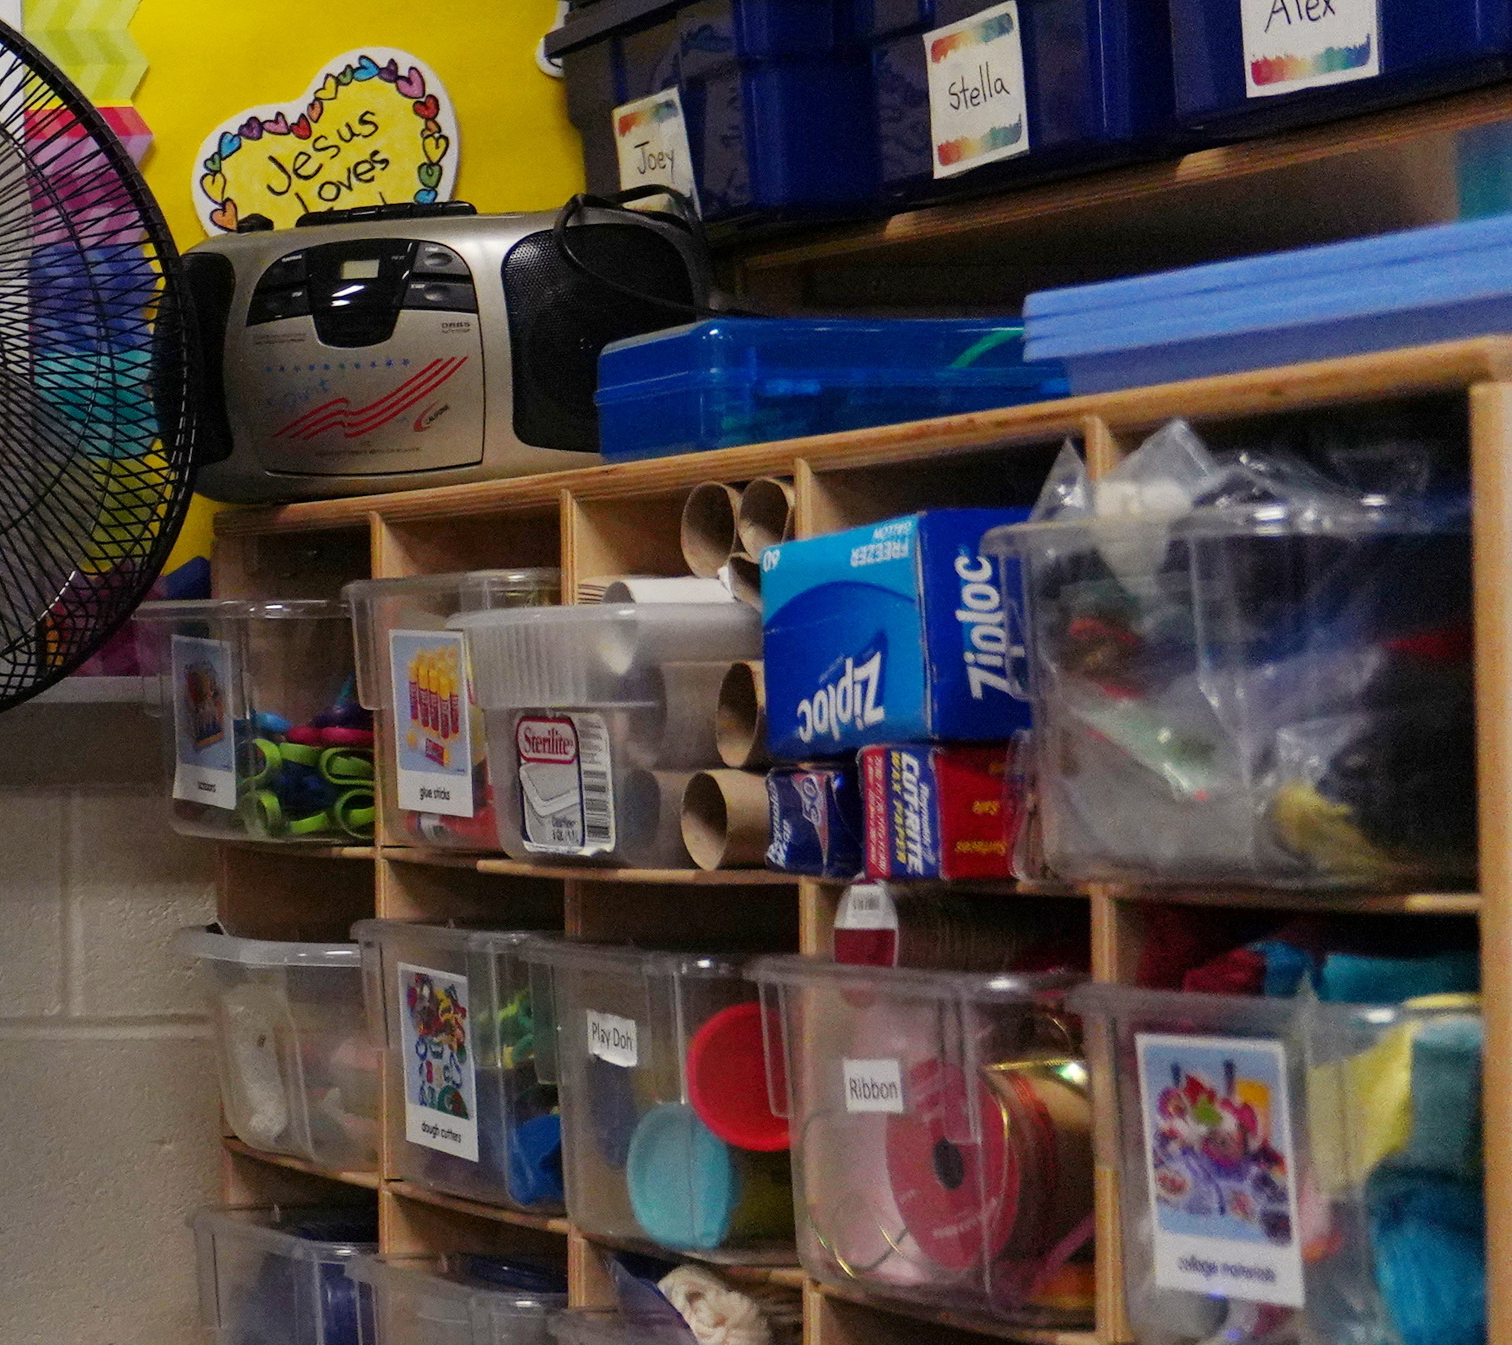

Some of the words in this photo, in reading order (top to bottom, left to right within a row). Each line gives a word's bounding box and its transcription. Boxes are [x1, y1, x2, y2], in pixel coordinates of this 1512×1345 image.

[948, 68, 1011, 114] Stella
[265, 109, 380, 197] Jesus
[634, 140, 676, 185] Joey
[849, 540, 910, 568] FREEZER
[953, 555, 1026, 700] Ziploc
[797, 650, 886, 744] Ziploc
[524, 726, 571, 755] Sterilite
[419, 786, 433, 801] glue
[848, 1076, 898, 1101] Ribbon
